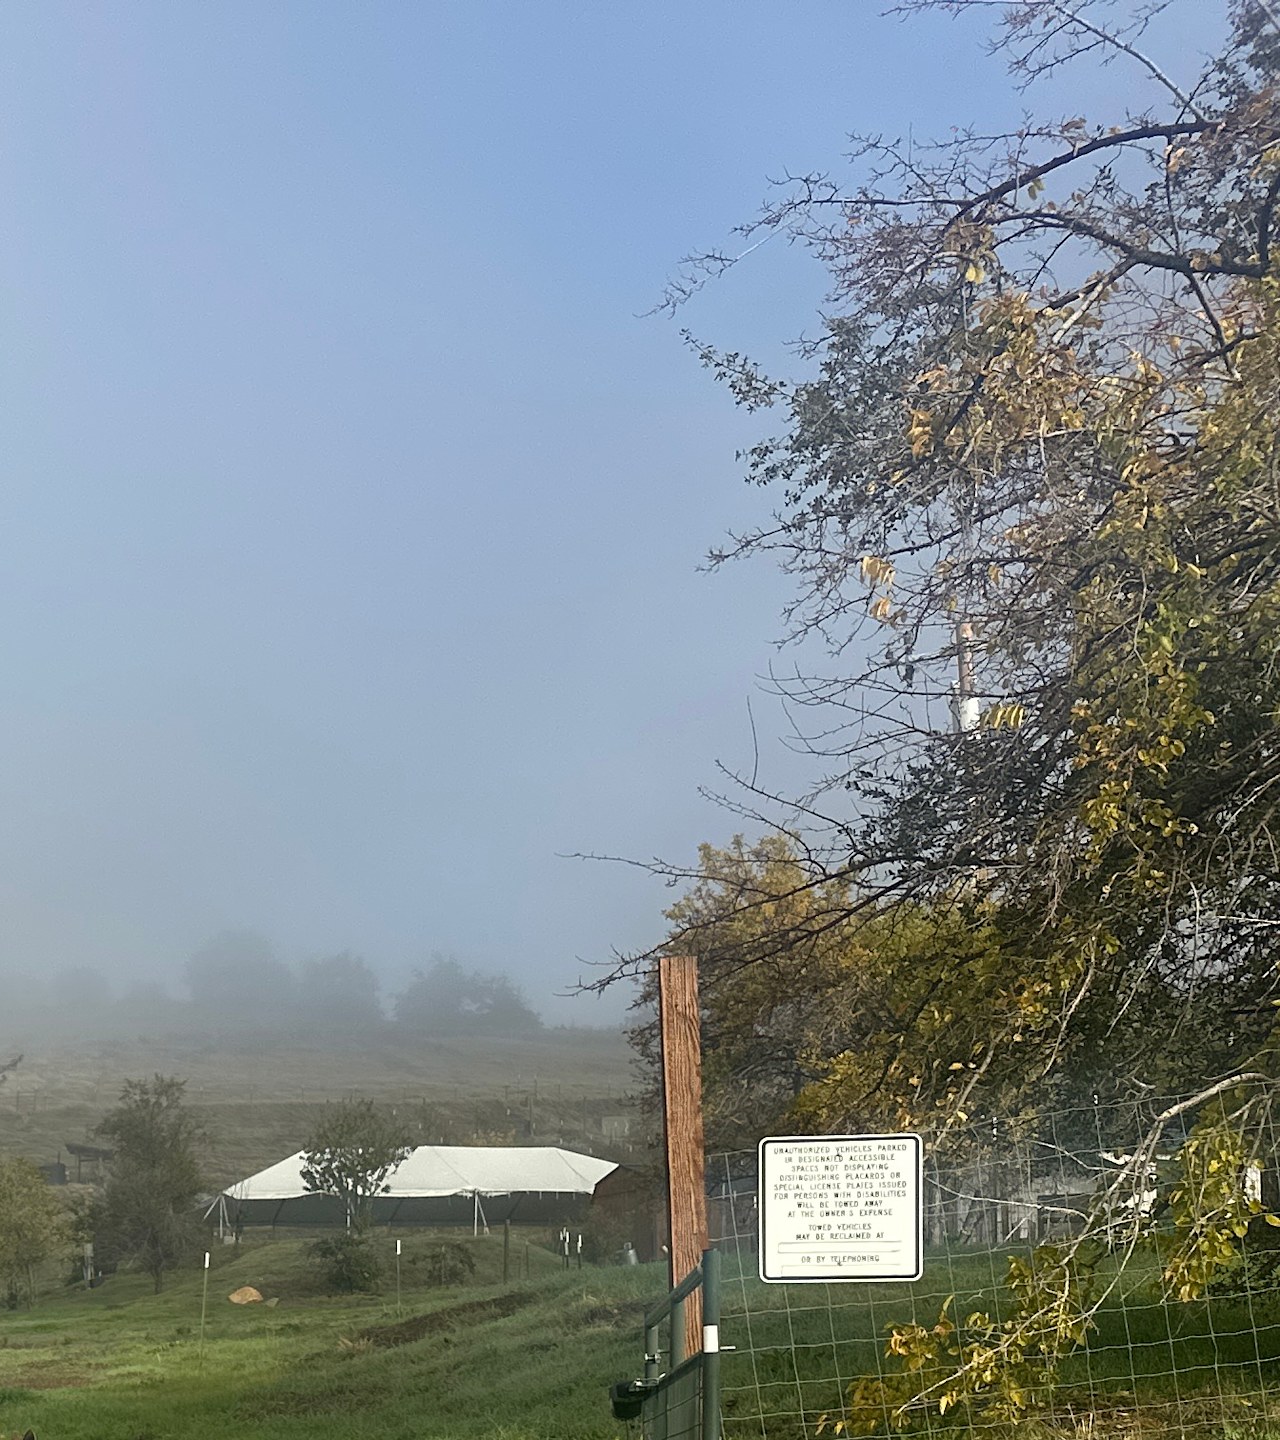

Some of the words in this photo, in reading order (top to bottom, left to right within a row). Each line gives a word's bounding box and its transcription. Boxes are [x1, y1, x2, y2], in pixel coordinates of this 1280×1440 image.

[773, 1146, 830, 1155] UNAUTHORIZED
[835, 1145, 872, 1154] VEHICLES
[877, 1144, 907, 1152] PARKED
[798, 1154, 844, 1163] DESIGNATED
[848, 1153, 895, 1162] ACCESSIBLE
[824, 1164, 838, 1172] NOT
[844, 1162, 889, 1171] DISPLAYING
[845, 1172, 885, 1181] PLACARDS
[774, 1183, 803, 1191] SPECIAL
[810, 1182, 841, 1190] LICENSE
[846, 1181, 874, 1189] PLATES
[879, 1180, 907, 1188] ISSUED
[774, 1192, 789, 1200] FOR
[793, 1192, 829, 1200] PERSONS
[856, 1190, 907, 1199] DISABILITIES
[796, 1201, 813, 1209] WILL
[834, 1200, 859, 1208] TOWED
[864, 1199, 883, 1208] AWAY
[801, 1210, 814, 1218] THE
[819, 1209, 854, 1218] OWNERS
[859, 1208, 893, 1217] EXPENSE
[837, 1223, 872, 1231] VEHICLES
[795, 1233, 810, 1241] MAY
[830, 1232, 871, 1240] RECLAIMED
[816, 1255, 826, 1264] BY
[831, 1255, 880, 1264] TELEPHONING
